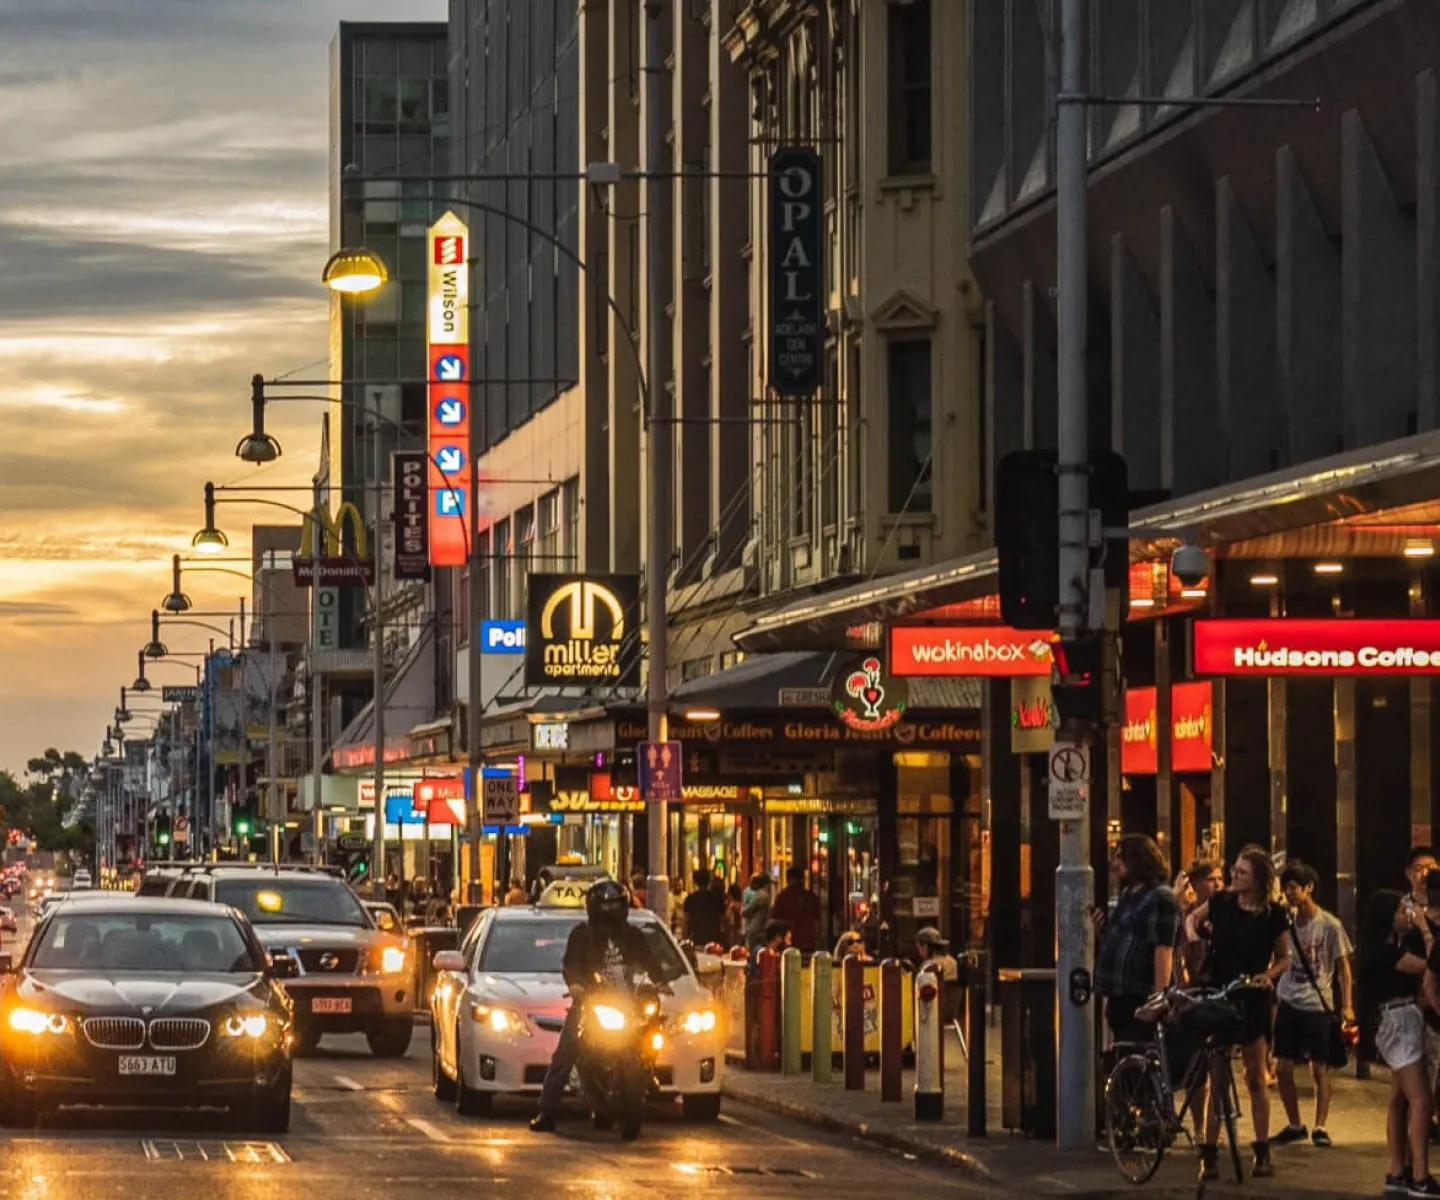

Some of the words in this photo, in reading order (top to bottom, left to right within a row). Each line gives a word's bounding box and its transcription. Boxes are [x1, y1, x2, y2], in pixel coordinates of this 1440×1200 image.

[779, 166, 812, 301] OPAL
[443, 270, 457, 333] Wilson
[404, 461, 422, 553] POLITES
[442, 490, 460, 513] P
[319, 590, 334, 647] OTE
[488, 628, 525, 647] Poli
[912, 638, 1025, 662] wokinabox
[1234, 647, 1355, 667] Hudsons
[544, 664, 620, 677] apartments
[488, 781, 514, 793] ONE
[487, 797, 514, 809] WAY
[555, 886, 586, 898] TAX
